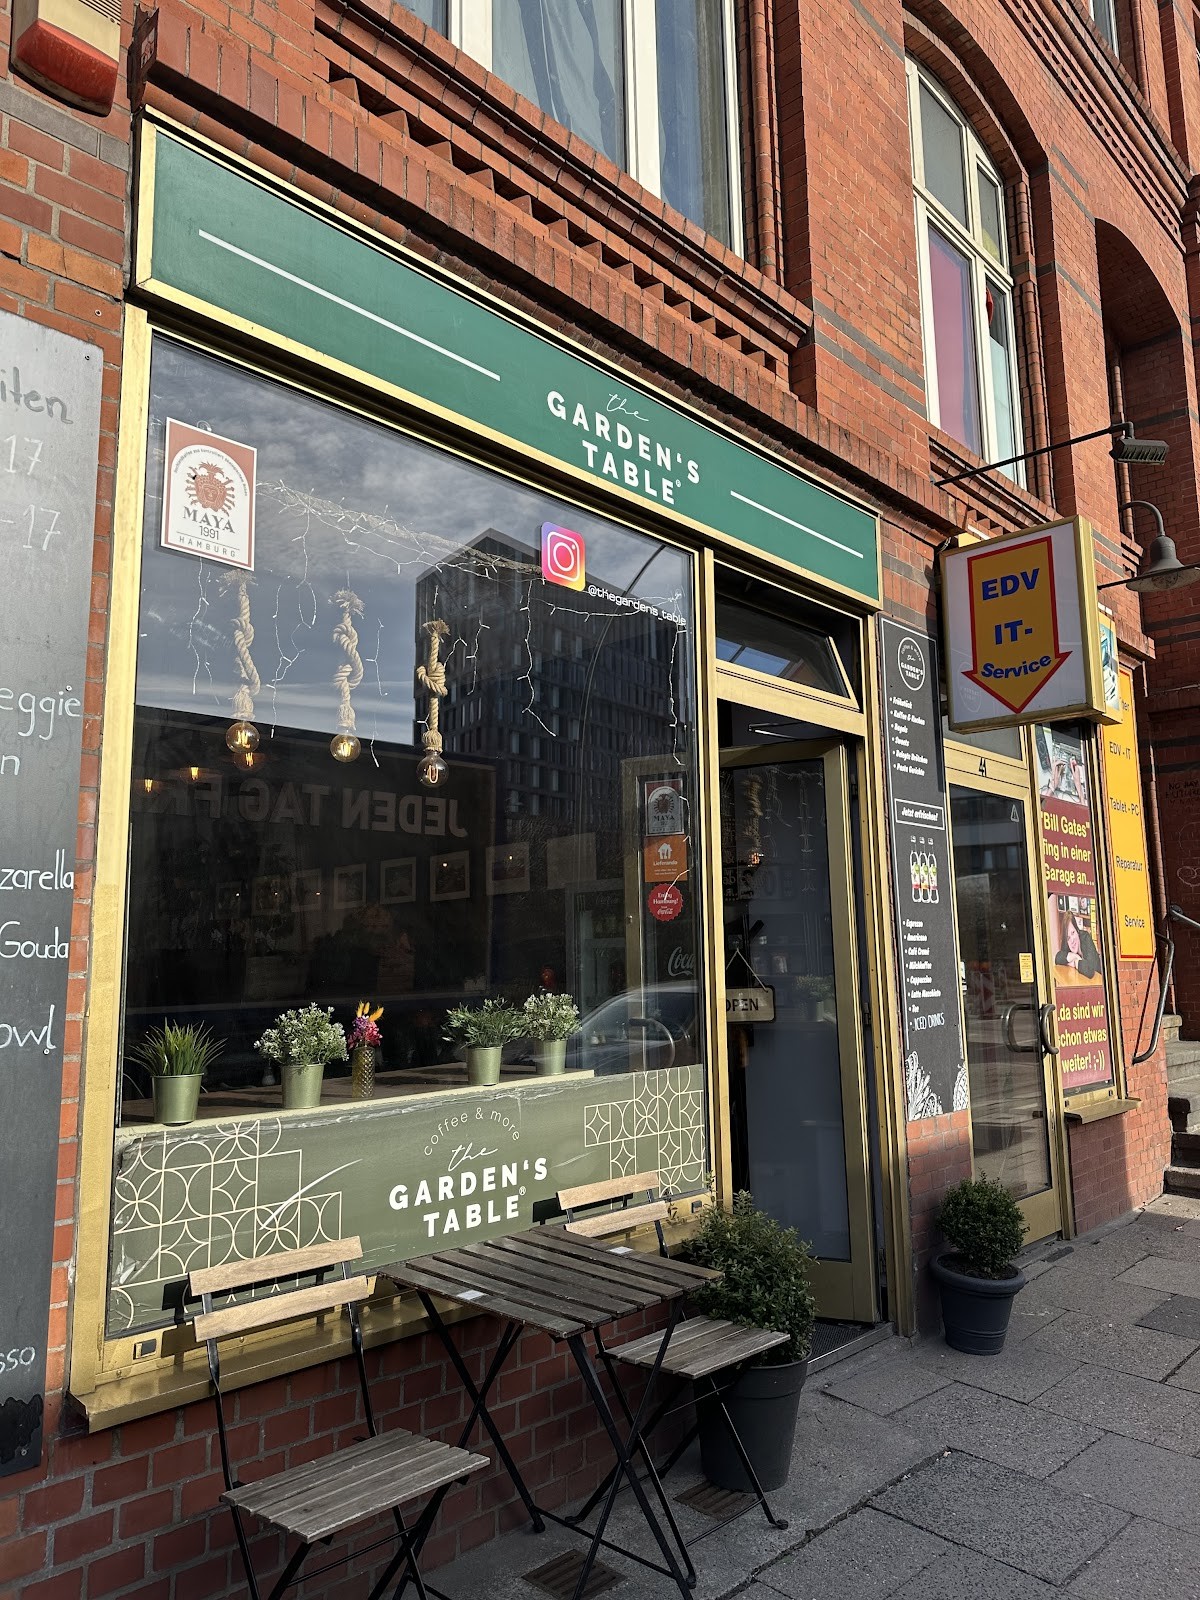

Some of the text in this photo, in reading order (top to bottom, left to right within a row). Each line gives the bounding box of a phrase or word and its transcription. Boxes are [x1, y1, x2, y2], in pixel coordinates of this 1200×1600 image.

[606, 393, 649, 422] the
[547, 391, 700, 484] GARDEN'S
[182, 506, 235, 533] MAYA
[200, 525, 219, 540] 1991
[179, 536, 236, 558] HAMBURG
[981, 568, 1039, 600] EDV
[588, 585, 686, 626] @thegardens_table
[994, 620, 1033, 645] IT-
[981, 655, 1052, 679] Service
[0, 687, 81, 740] eggie
[1109, 741, 1121, 756] EDV
[979, 757, 987, 777] 4
[1110, 797, 1127, 813] Tablet
[1131, 803, 1140, 816] PC
[1061, 816, 1090, 838] Gates"
[1060, 842, 1069, 859] in
[1071, 845, 1091, 862] einer
[1116, 856, 1143, 871] Reparatur
[0, 848, 74, 890] zarella
[1045, 863, 1075, 887] Garage
[1124, 915, 1145, 928] Service
[0, 921, 69, 959] Gouda
[1073, 1001, 1090, 1020] sind
[1092, 1001, 1104, 1018] wir
[1084, 1027, 1107, 1044] etwas
[1062, 1052, 1092, 1073] weiter!
[424, 1107, 520, 1156] coffee & more
[448, 1142, 498, 1172] the
[389, 1157, 548, 1210] GARDEN'S
